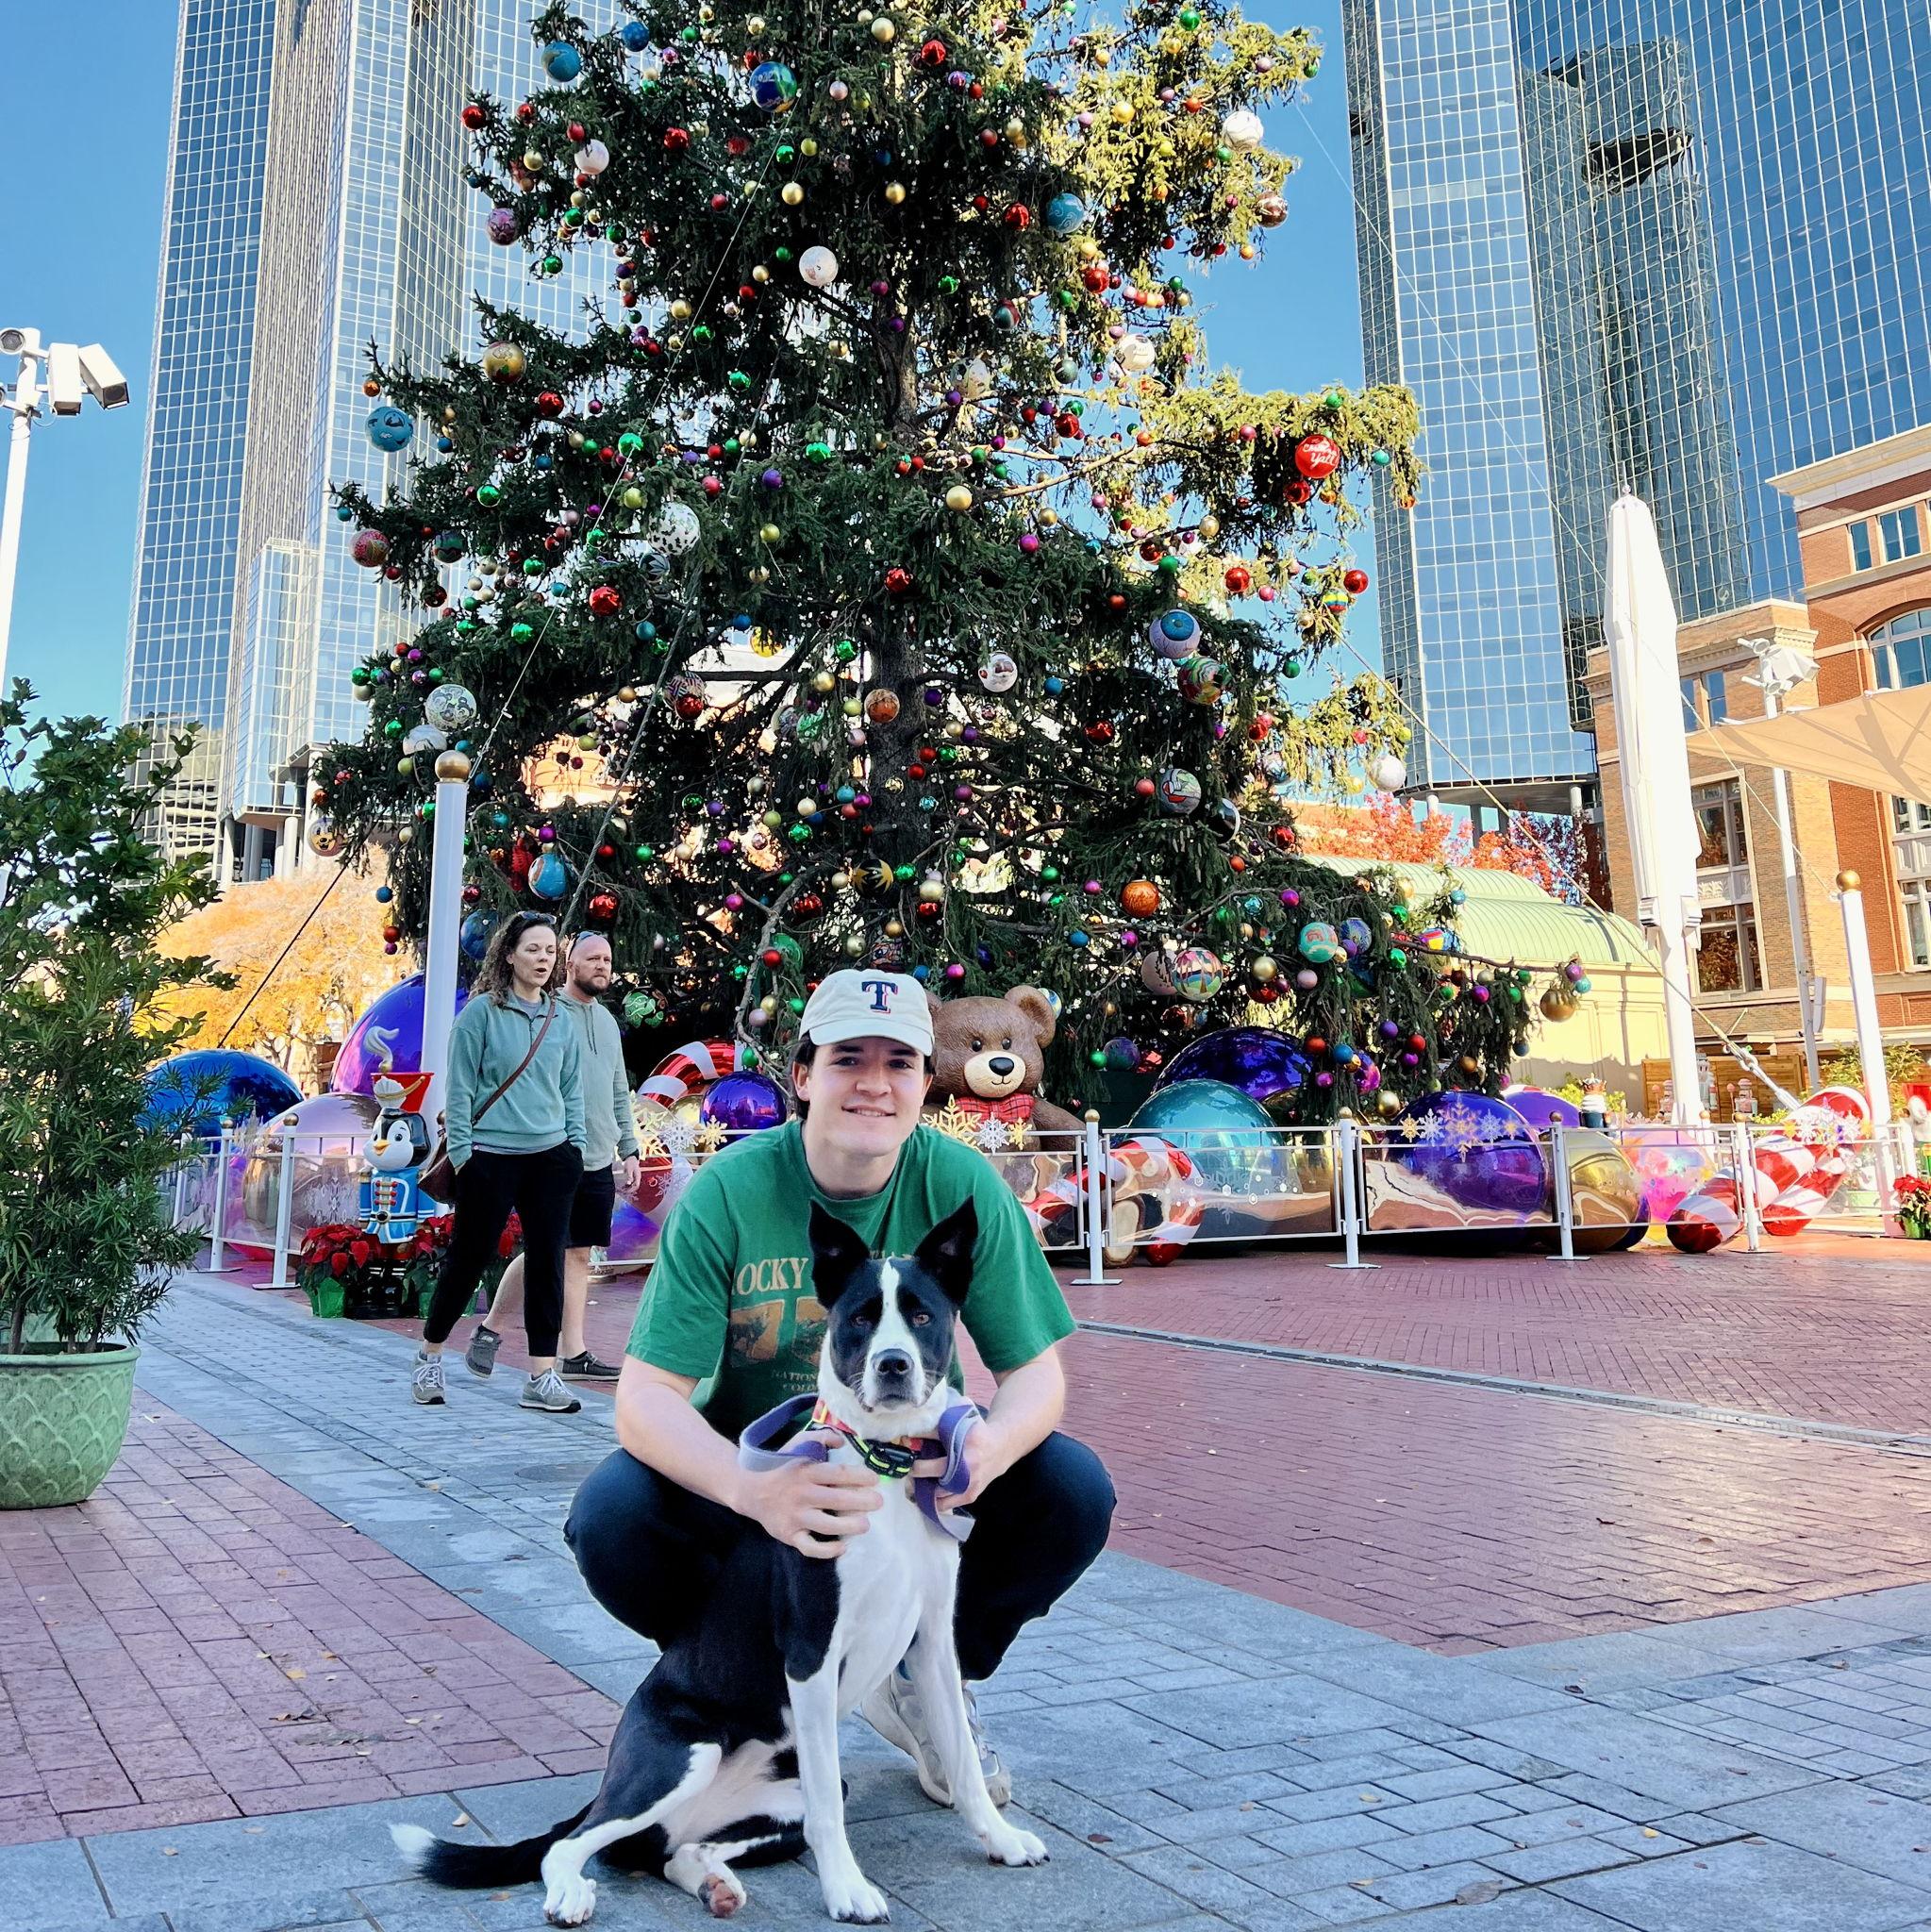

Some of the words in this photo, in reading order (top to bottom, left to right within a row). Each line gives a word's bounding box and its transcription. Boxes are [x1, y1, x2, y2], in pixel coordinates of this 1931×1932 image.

[861, 981, 898, 1014] T
[731, 1257, 808, 1295] OCKY
[771, 1371, 818, 1382] NATION
